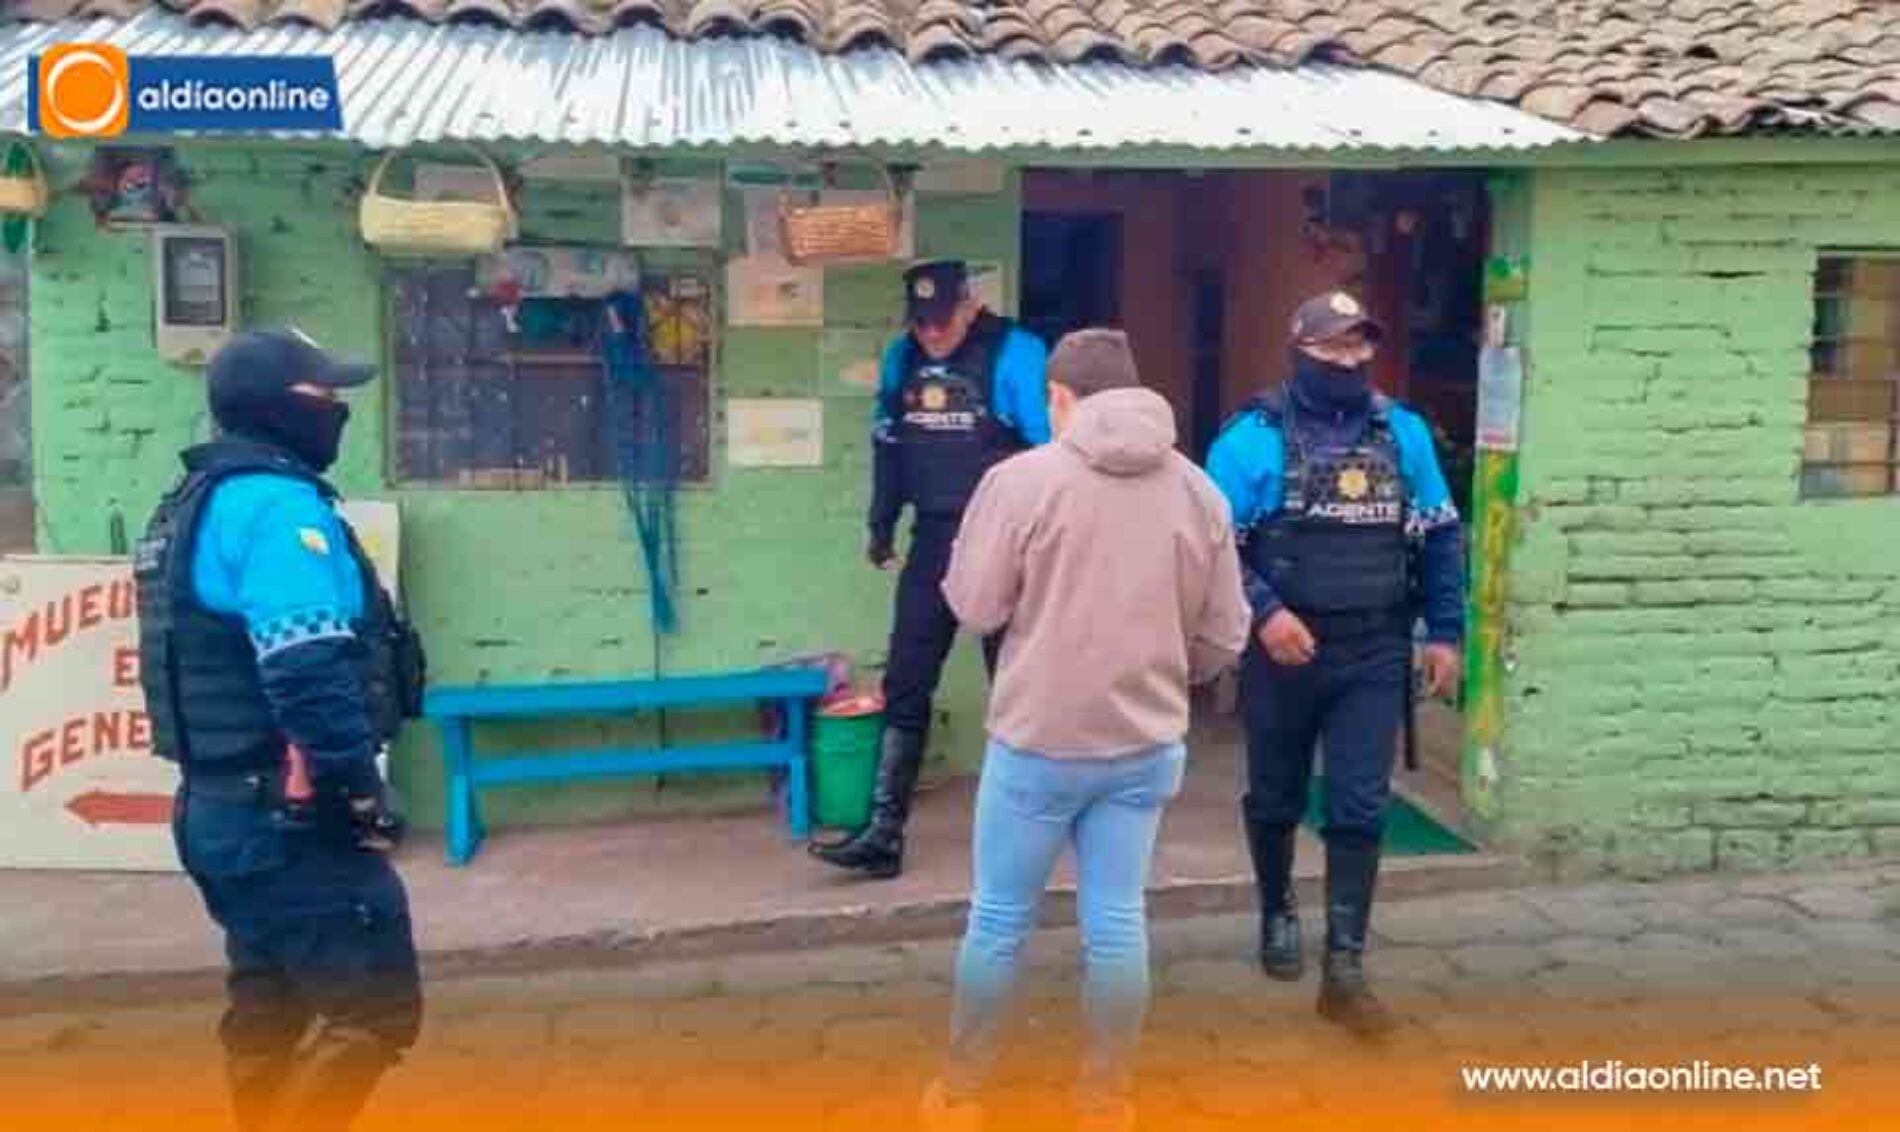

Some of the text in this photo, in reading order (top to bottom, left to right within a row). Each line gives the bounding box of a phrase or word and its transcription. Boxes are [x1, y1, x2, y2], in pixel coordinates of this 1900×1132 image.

[1306, 502, 1399, 517] AGENTE
[114, 648, 139, 687] E
[21, 711, 151, 792] GENE
